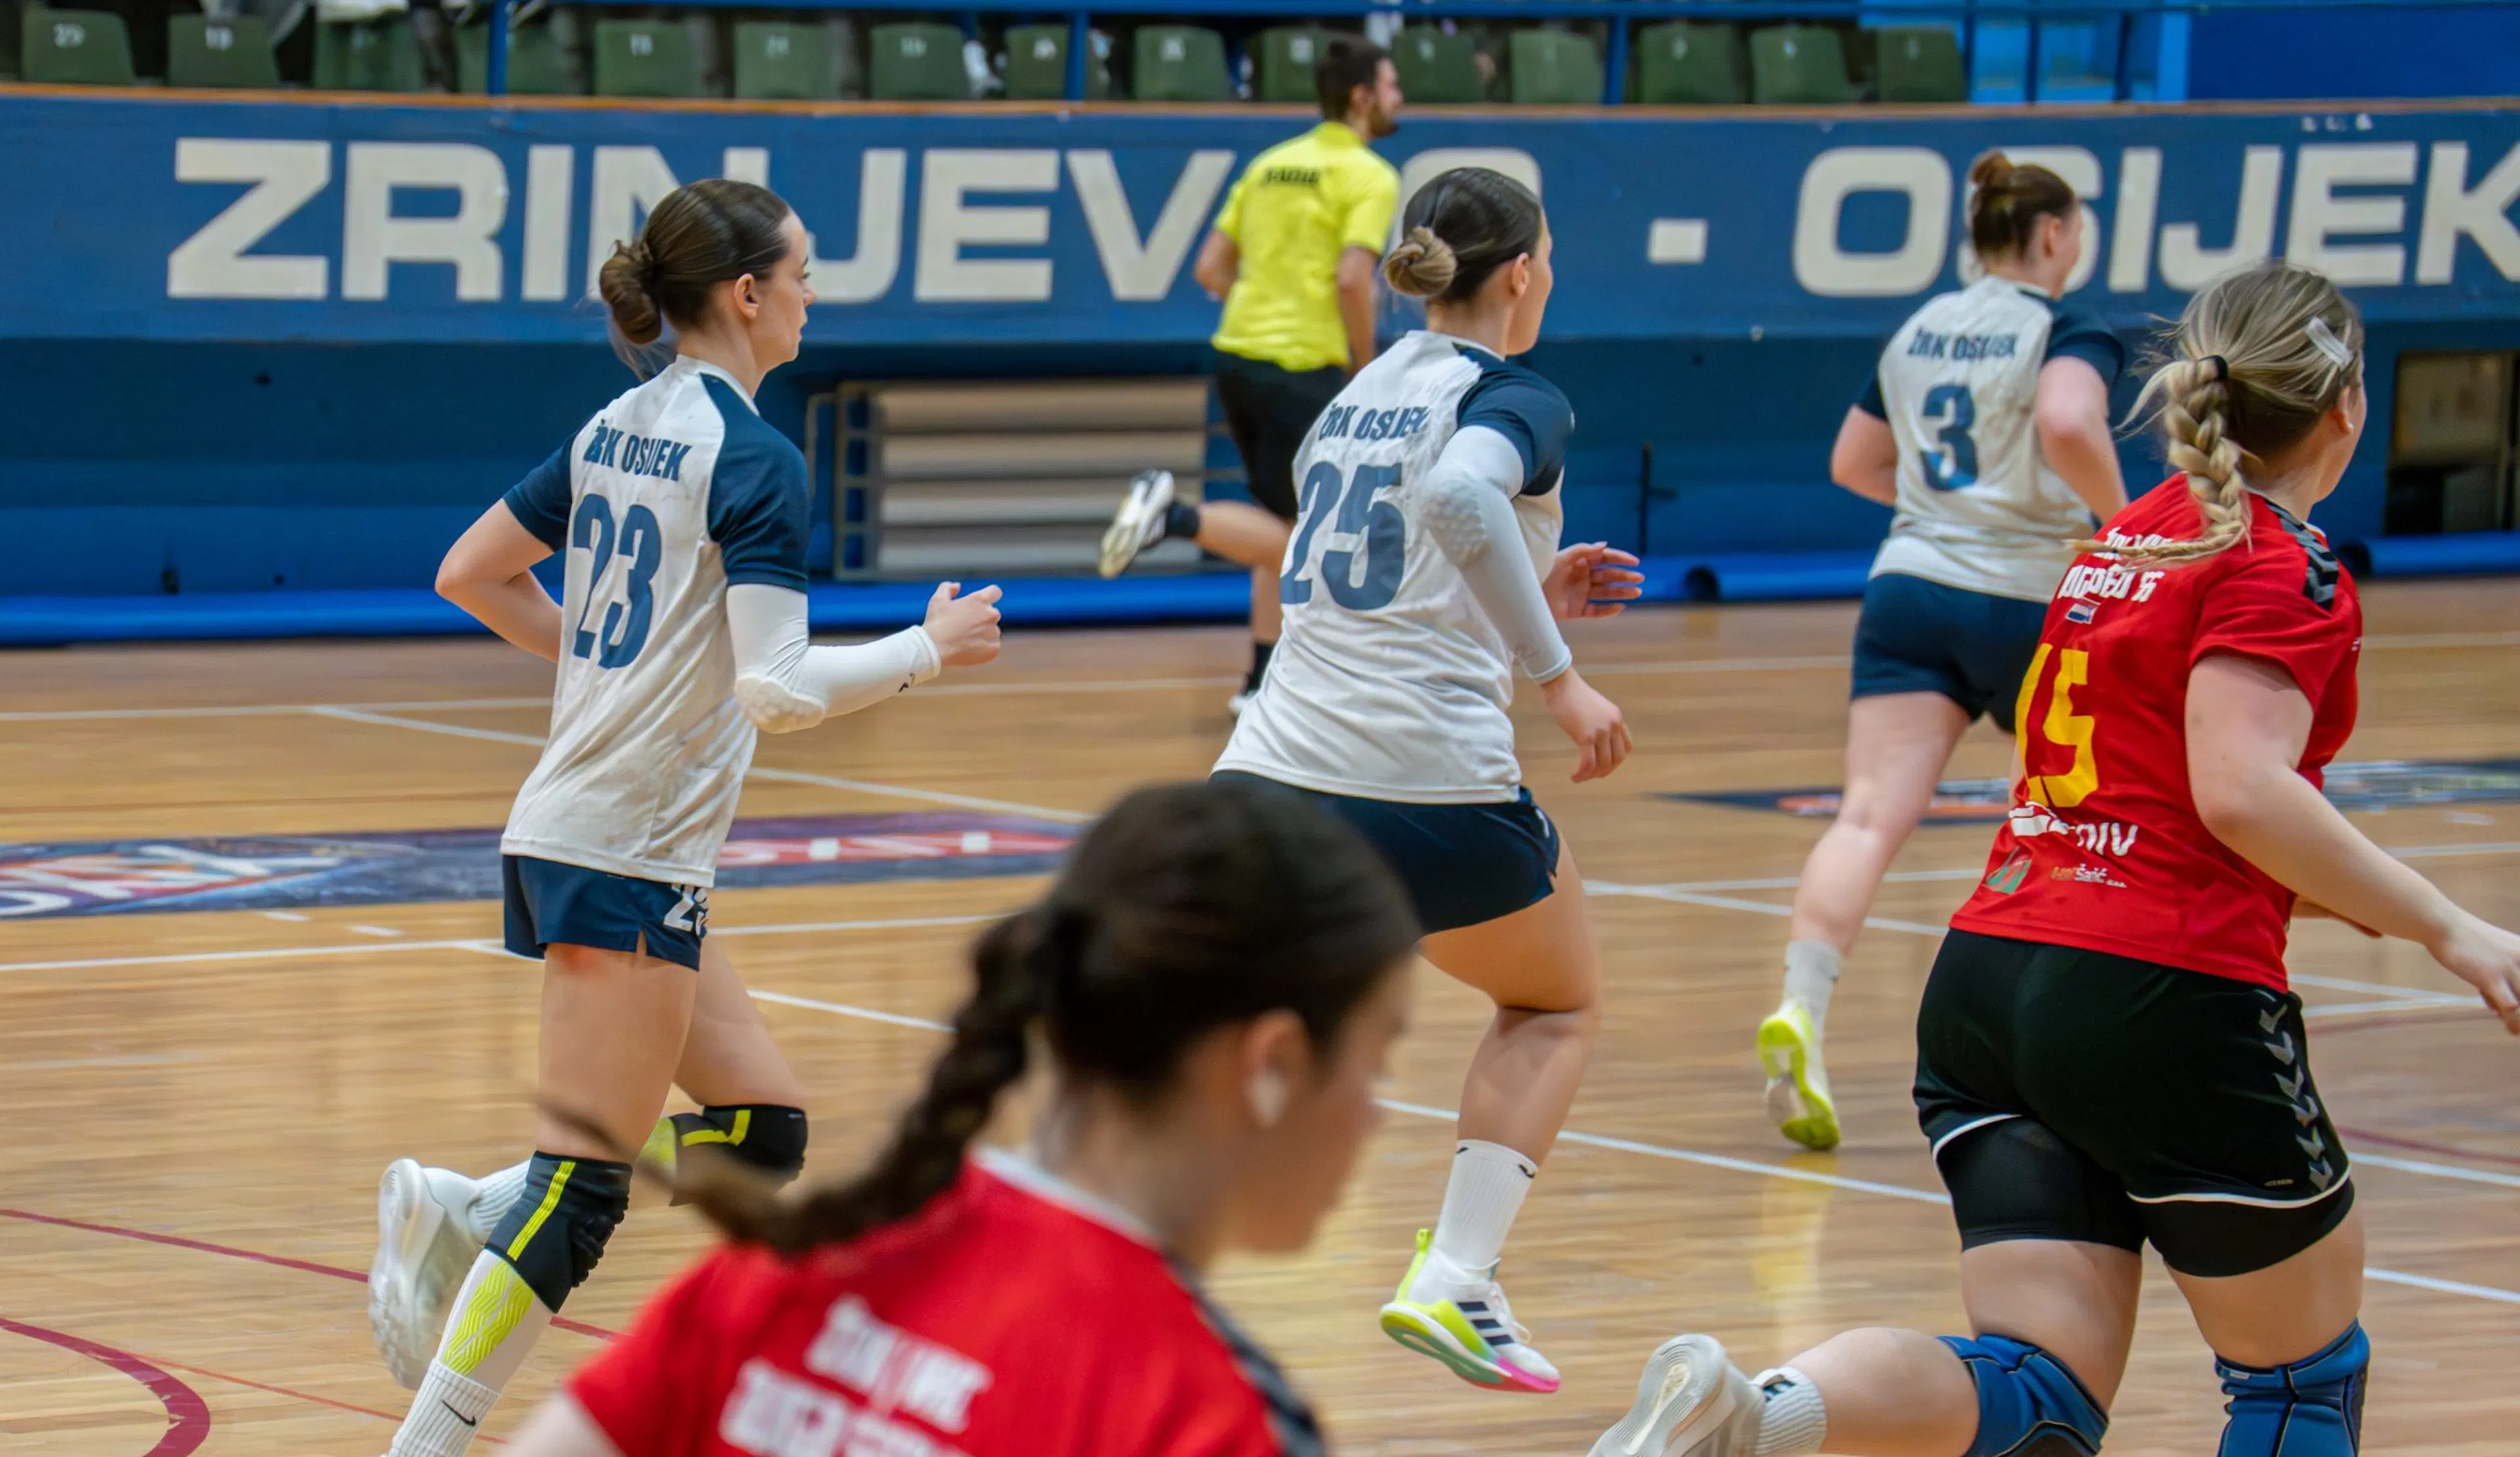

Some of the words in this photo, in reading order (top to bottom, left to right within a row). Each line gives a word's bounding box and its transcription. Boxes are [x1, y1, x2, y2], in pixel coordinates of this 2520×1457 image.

[1920, 383, 1979, 492] 3
[573, 493, 662, 669] 23
[1280, 461, 1405, 610] 25
